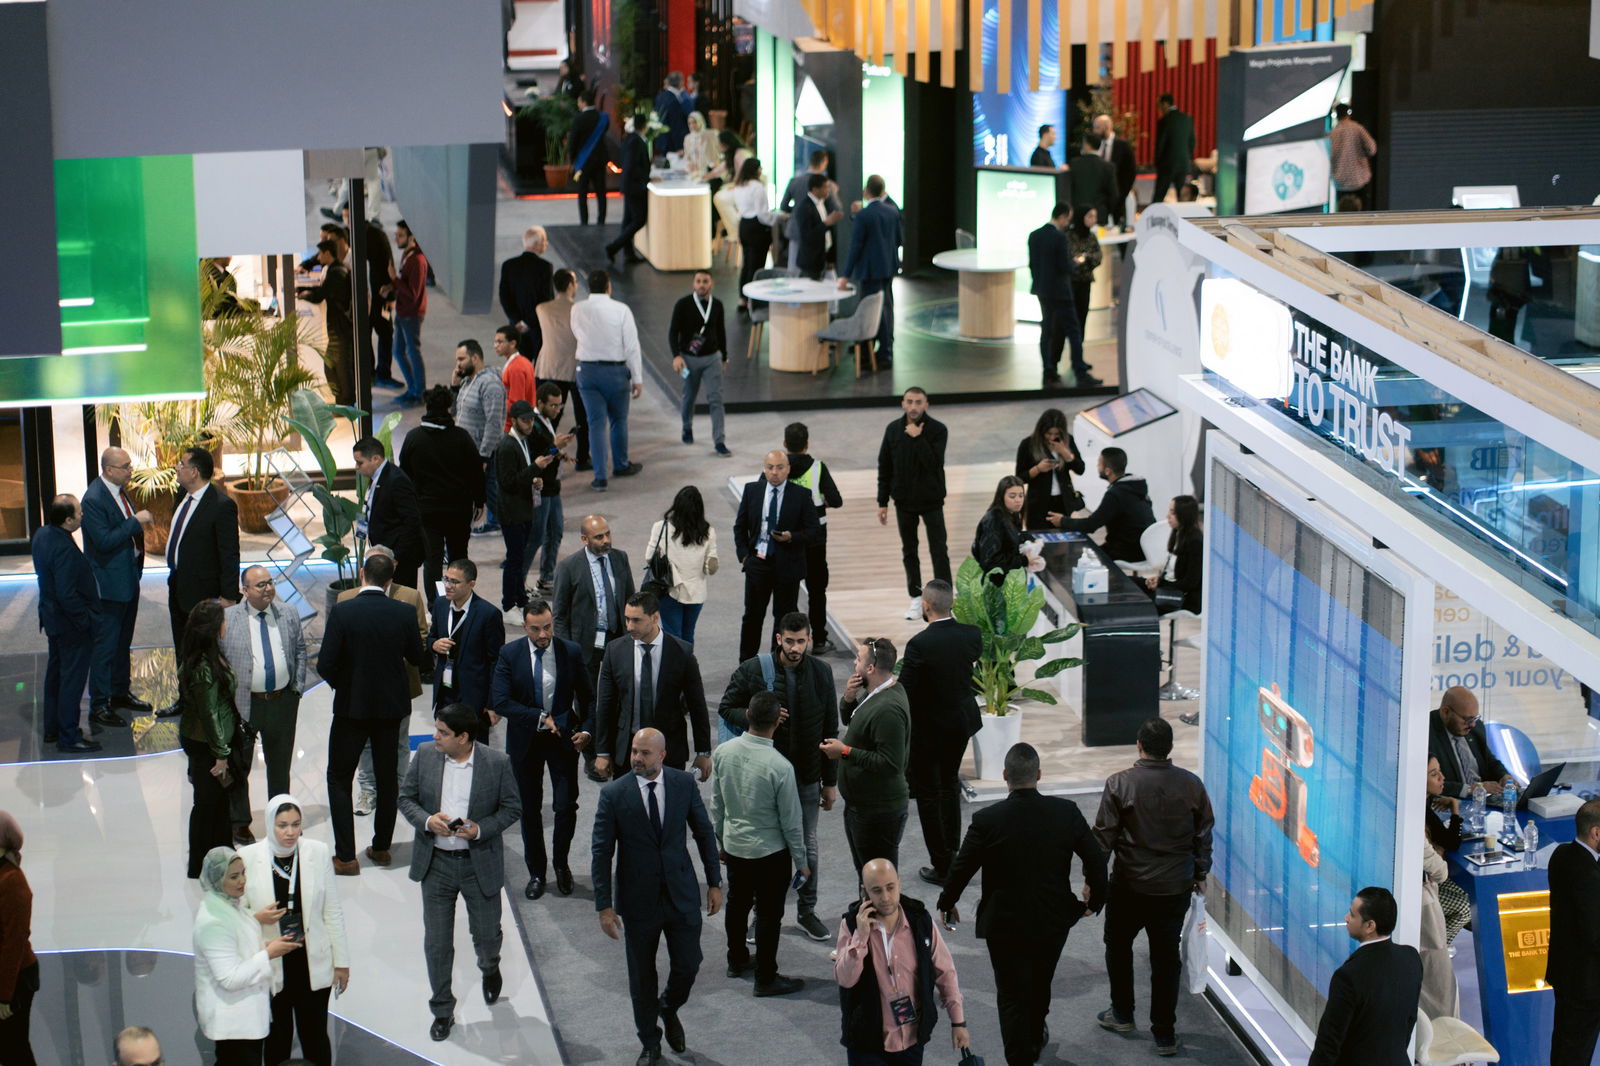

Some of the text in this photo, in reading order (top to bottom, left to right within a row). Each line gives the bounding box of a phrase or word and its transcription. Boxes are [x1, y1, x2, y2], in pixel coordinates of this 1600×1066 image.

[1294, 320, 1328, 374] THE
[1330, 341, 1379, 405] BANK
[1294, 361, 1412, 483] TO TRUST
